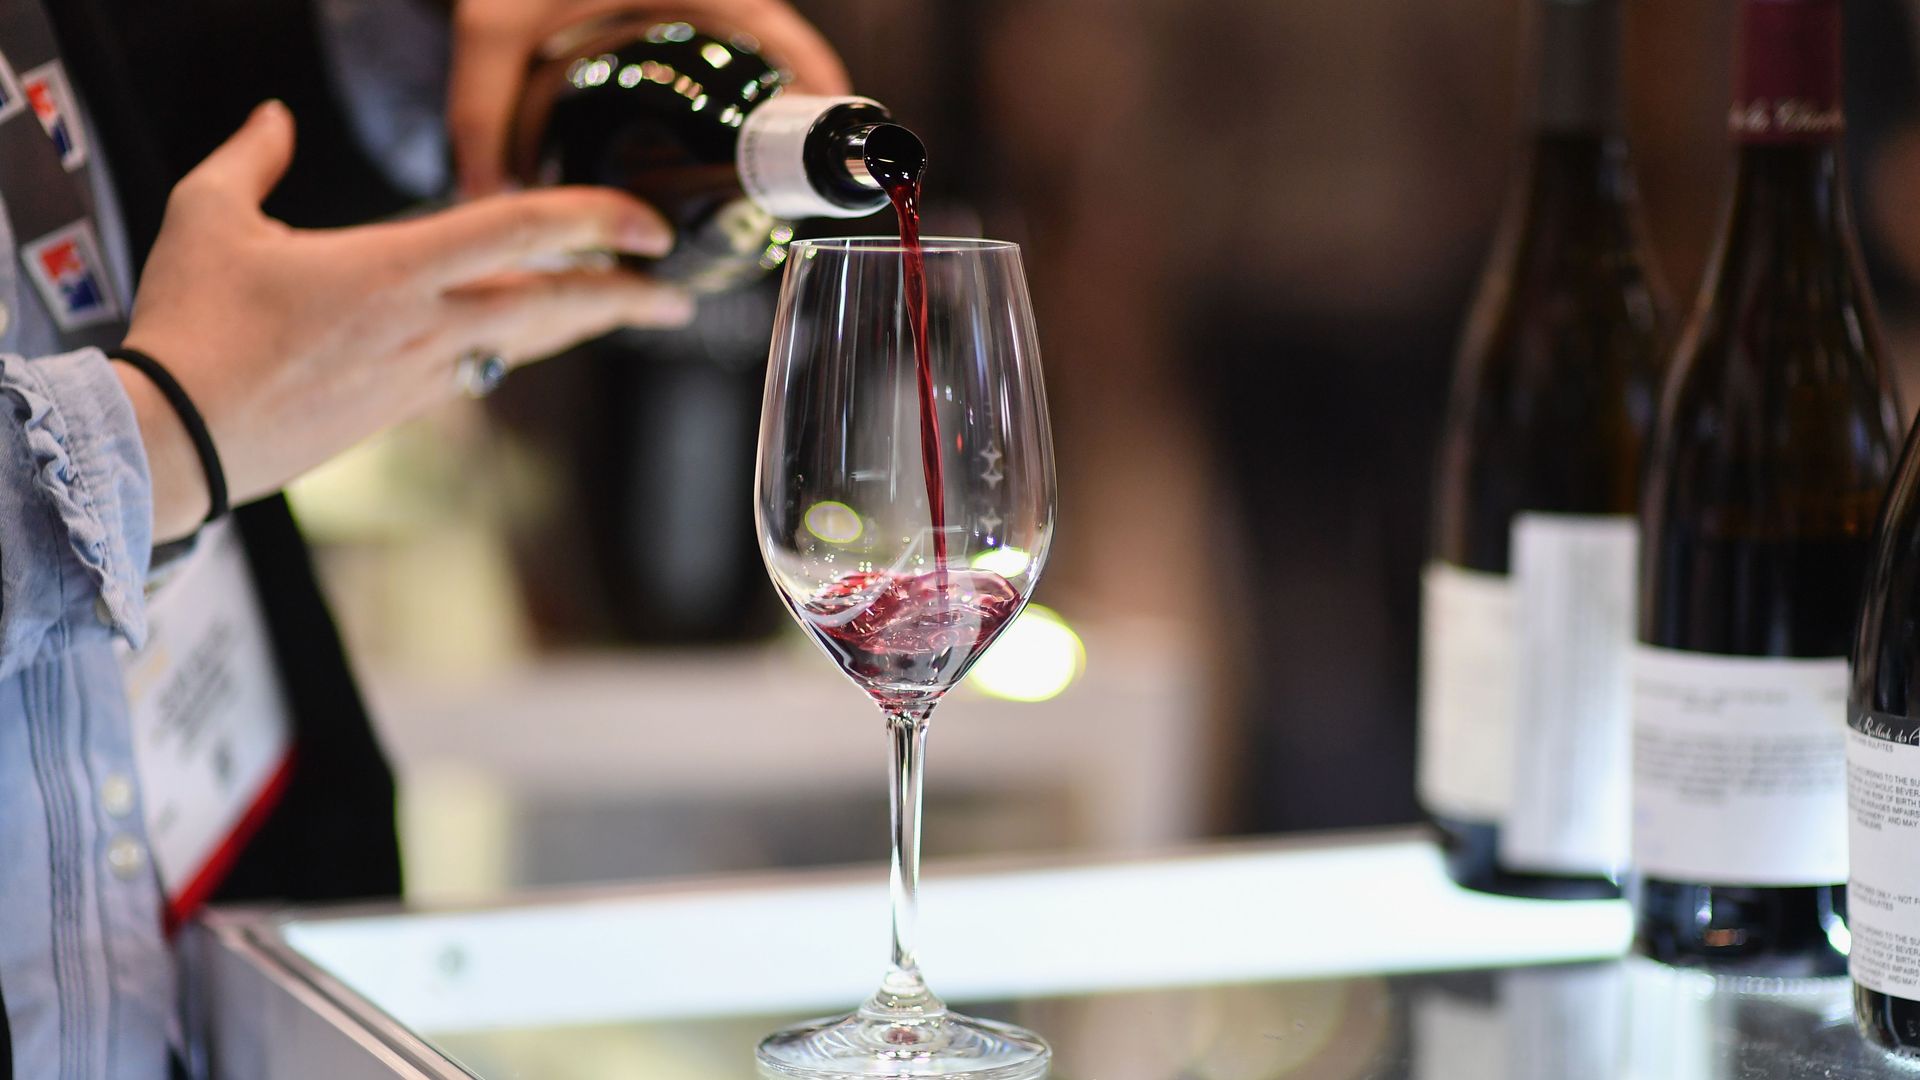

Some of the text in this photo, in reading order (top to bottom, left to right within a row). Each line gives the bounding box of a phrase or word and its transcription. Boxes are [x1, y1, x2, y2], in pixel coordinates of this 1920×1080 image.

[1895, 775, 1907, 786] THE
[1895, 797, 1917, 808] BIRTH
[1887, 816, 1902, 826] AND
[1902, 819, 1918, 828] MAY
[1898, 894, 1913, 905] NOT
[1895, 934, 1908, 945] THE
[1895, 955, 1917, 967] BIRTH
[1902, 977, 1918, 986] MAY
